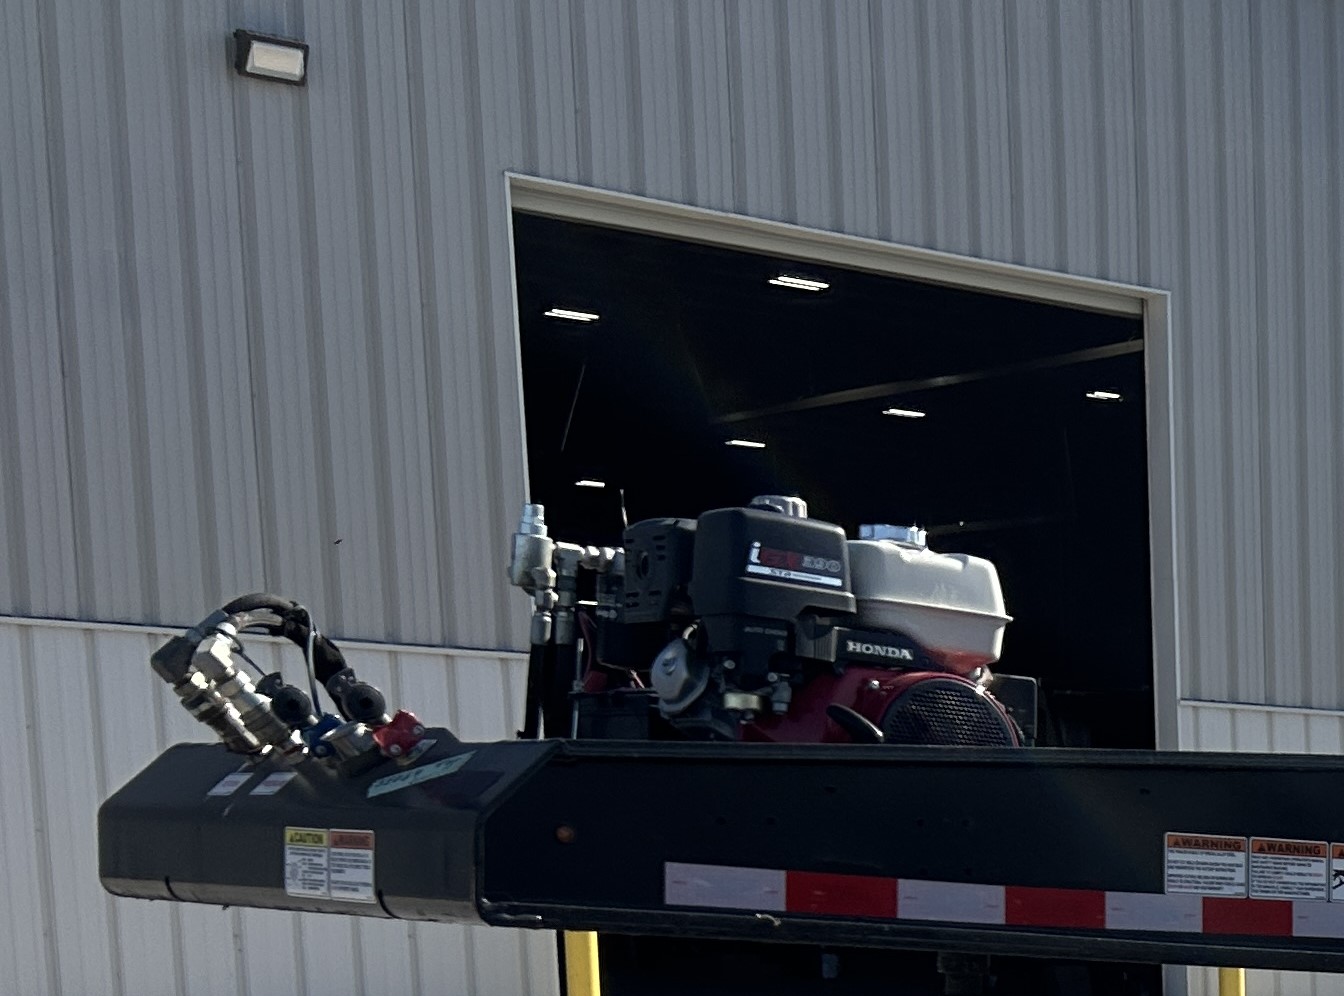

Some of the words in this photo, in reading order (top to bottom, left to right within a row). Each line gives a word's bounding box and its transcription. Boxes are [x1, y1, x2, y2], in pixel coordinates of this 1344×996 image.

[847, 640, 913, 660] HONDA
[1182, 838, 1241, 850] WARNING
[1266, 842, 1321, 855] WARNING
